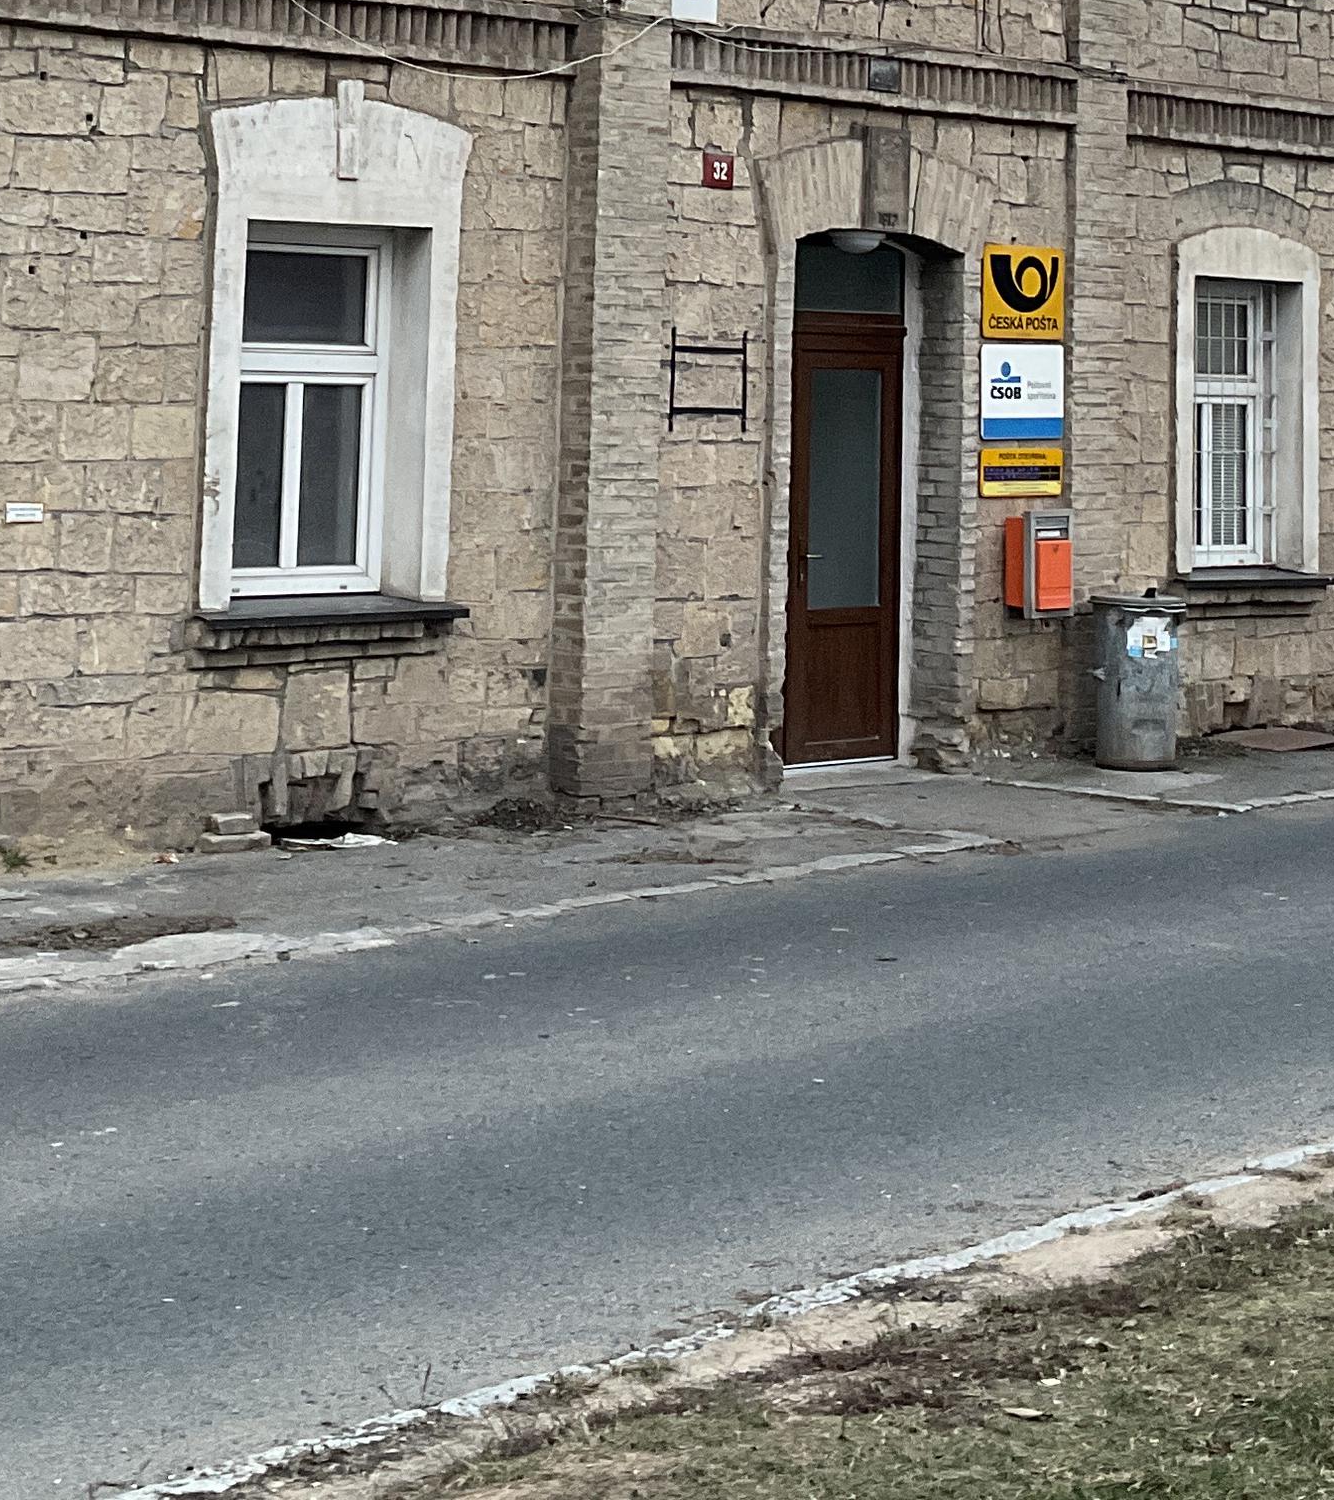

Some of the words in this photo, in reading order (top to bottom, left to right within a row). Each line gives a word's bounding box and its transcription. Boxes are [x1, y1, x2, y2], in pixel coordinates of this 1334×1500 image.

[713, 161, 728, 180] 32
[988, 313, 1024, 330] ČESKÁ
[1026, 314, 1059, 331] POŠTA
[990, 386, 1022, 400] ČSOB
